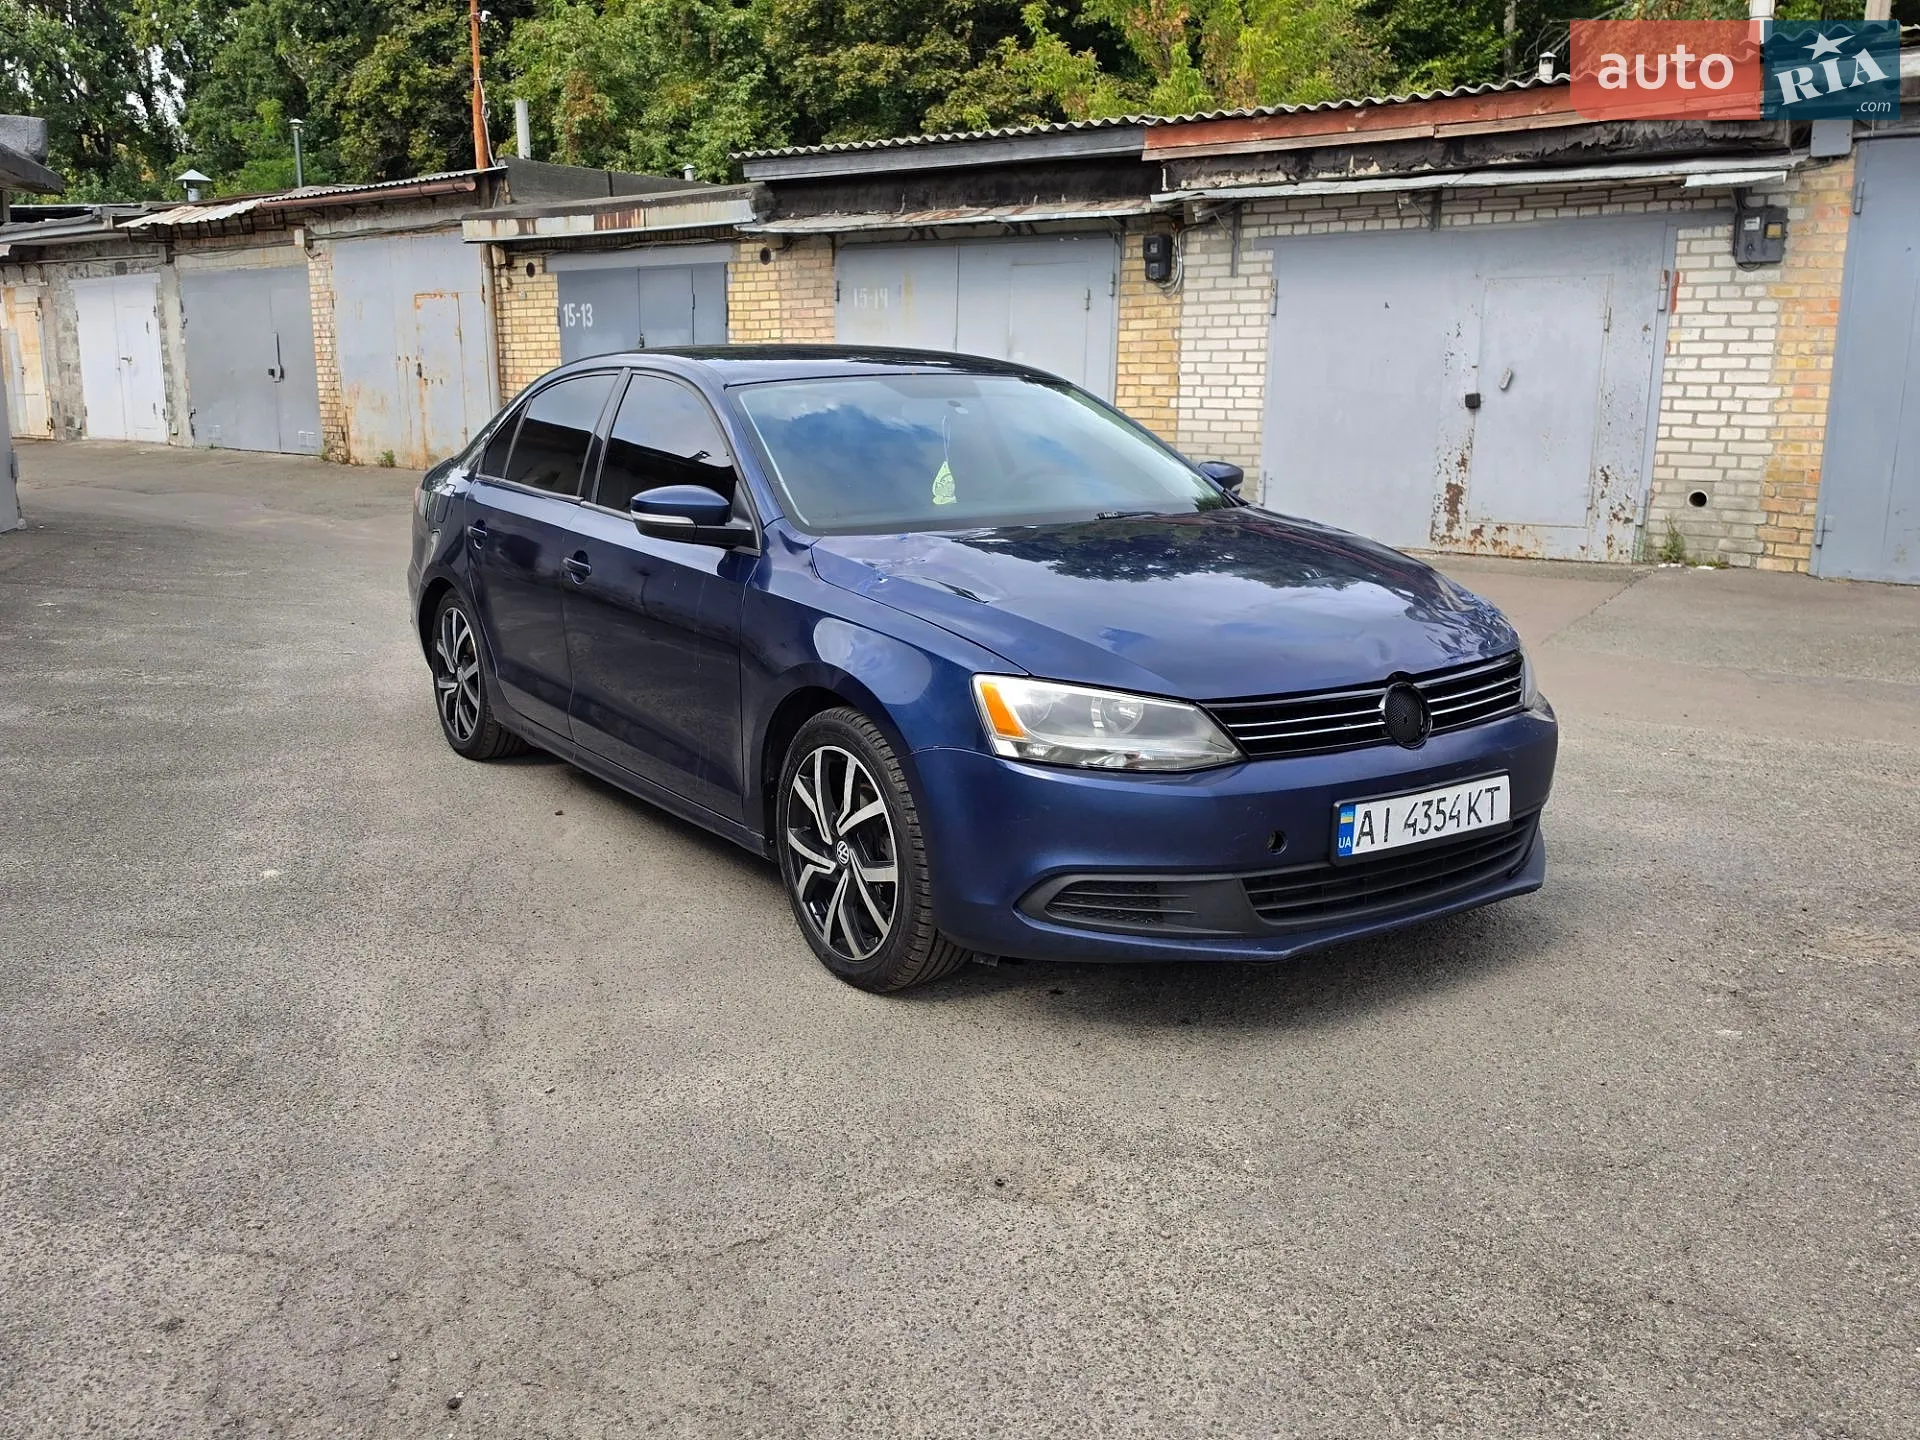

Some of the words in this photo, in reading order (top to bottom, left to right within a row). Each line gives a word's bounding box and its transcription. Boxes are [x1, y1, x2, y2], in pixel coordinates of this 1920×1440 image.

[563, 303, 593, 328] 15-13
[1356, 808, 1390, 847] AI
[1403, 795, 1461, 836] 4354
[1467, 786, 1501, 826] KT
[1338, 837, 1352, 849] UA
